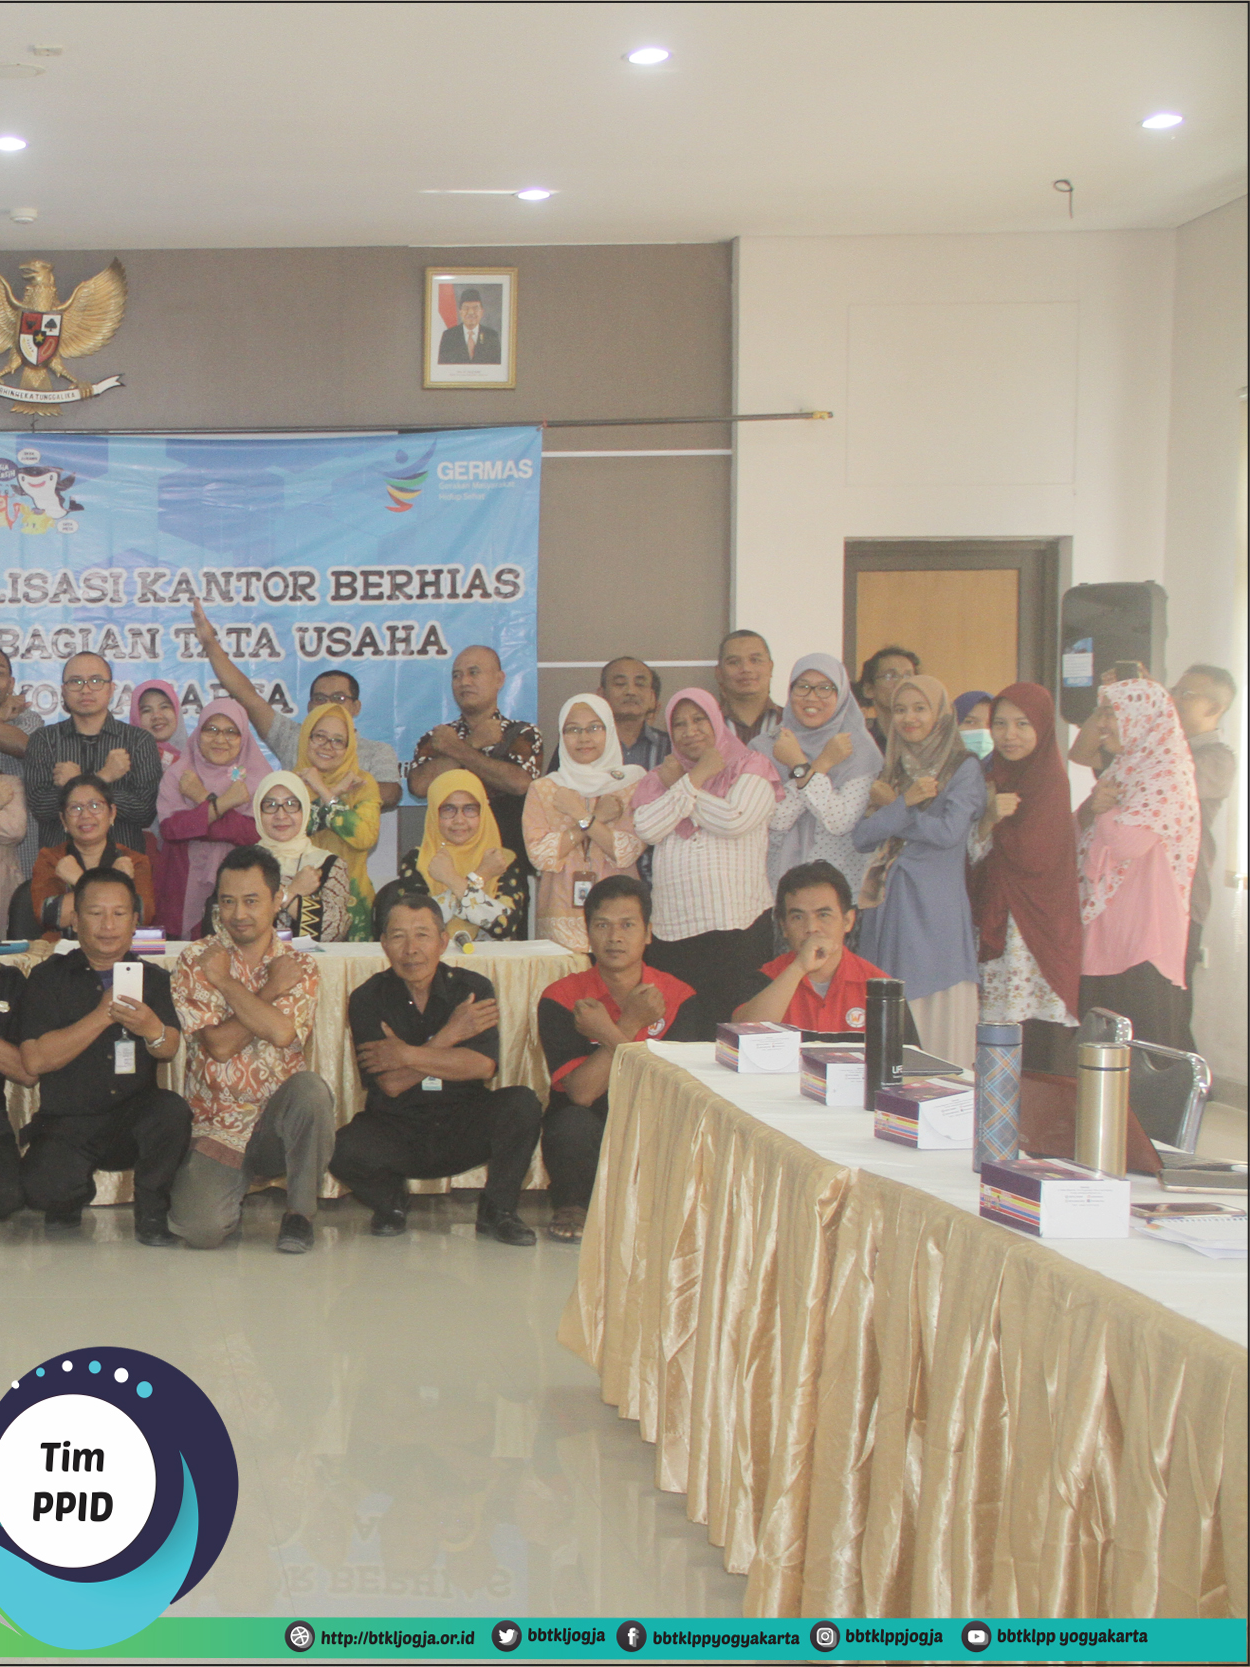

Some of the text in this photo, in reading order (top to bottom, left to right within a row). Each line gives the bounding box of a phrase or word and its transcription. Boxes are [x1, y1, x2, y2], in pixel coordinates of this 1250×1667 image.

[437, 459, 533, 480] GERMAS
[137, 571, 317, 602] KANTOR
[331, 568, 521, 602] BERHIAS
[295, 624, 448, 659] USAHA
